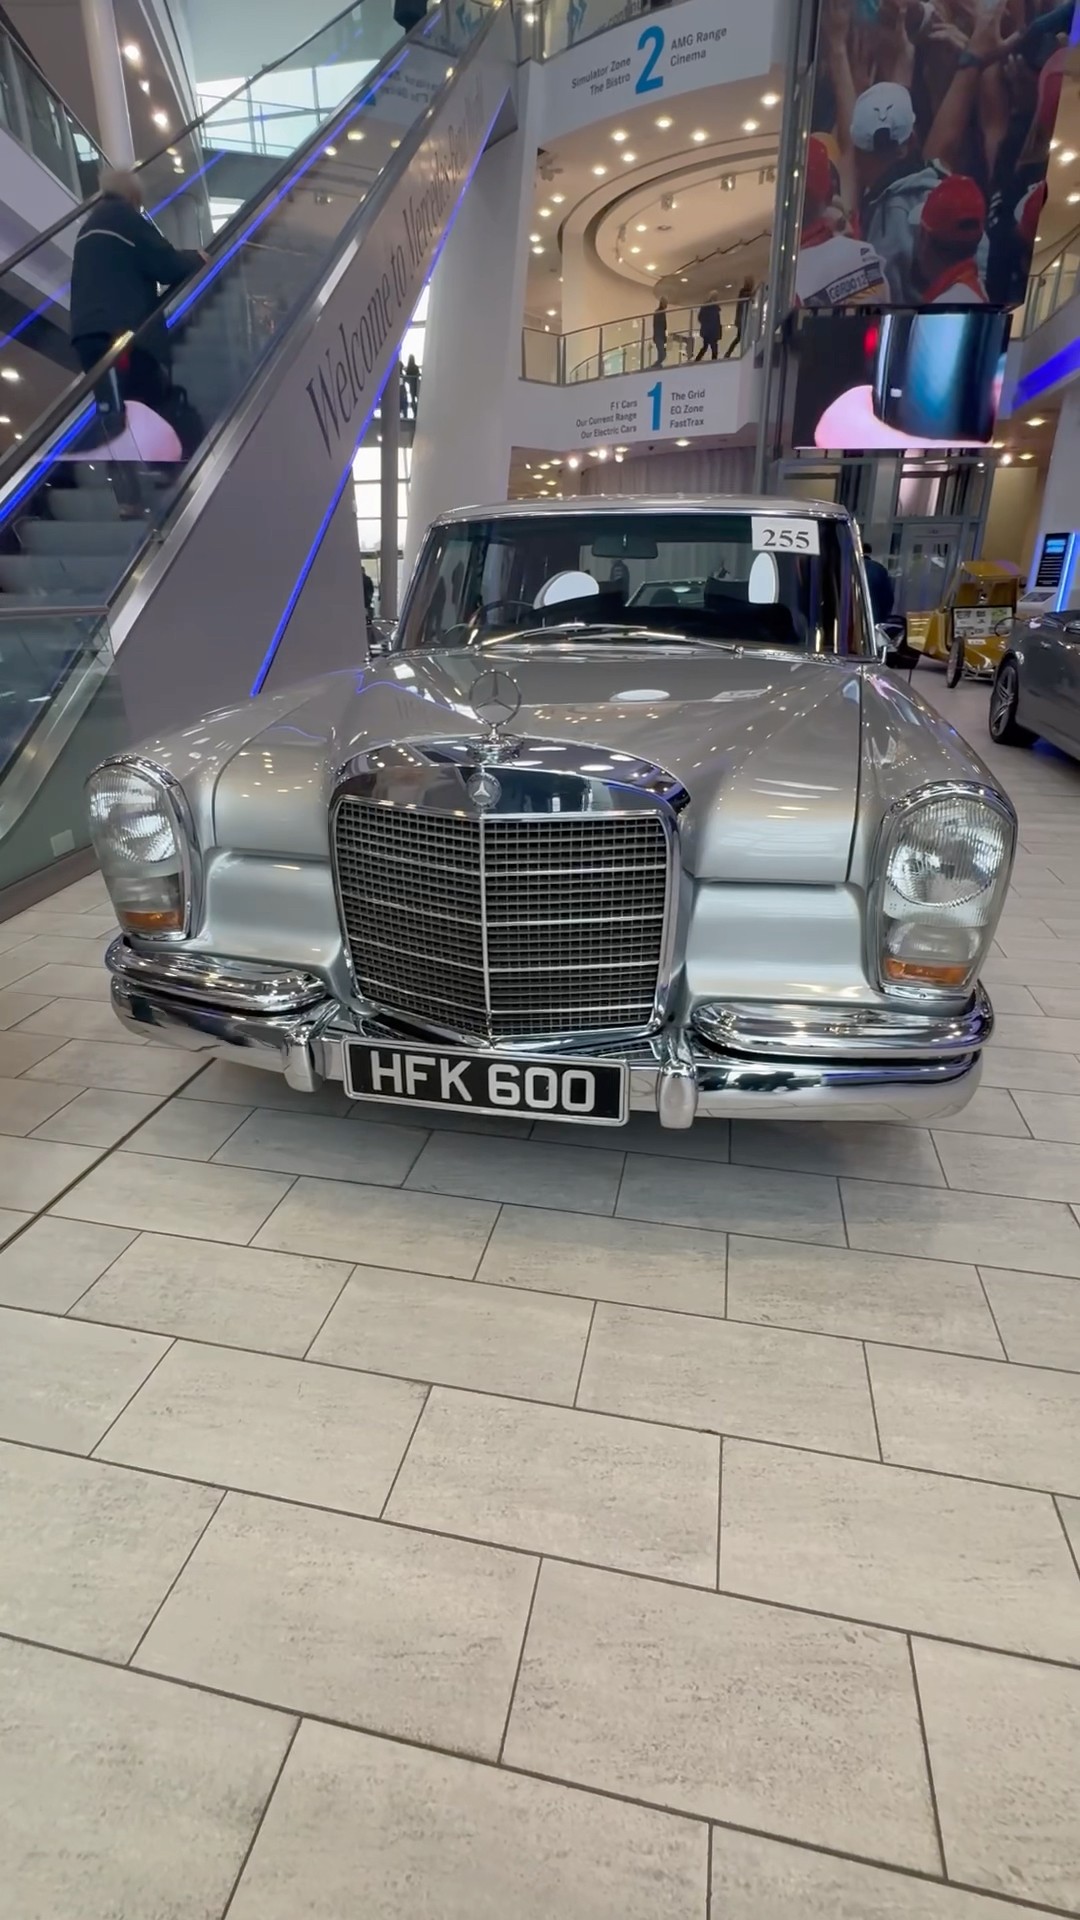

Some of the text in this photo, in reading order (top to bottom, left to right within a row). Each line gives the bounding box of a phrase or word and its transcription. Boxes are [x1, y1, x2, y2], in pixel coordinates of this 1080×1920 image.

[670, 27, 727, 51] AMG Range
[635, 25, 665, 95] 2
[670, 49, 706, 67] Cinema
[571, 57, 631, 89] Simulator Zone
[590, 72, 631, 96] The Bistro
[305, 273, 393, 460] Welcome
[390, 244, 406, 308] to
[671, 389, 705, 401] The Grid
[610, 400, 638, 411] F1 Cars
[647, 381, 662, 431] 1
[683, 404, 704, 413] Zone
[576, 412, 637, 428] Our Current Range
[669, 419, 704, 429] FastTrax
[581, 425, 637, 439] Our Electric Cars
[762, 529, 810, 549] 255
[370, 1050, 596, 1113] HFK 600
